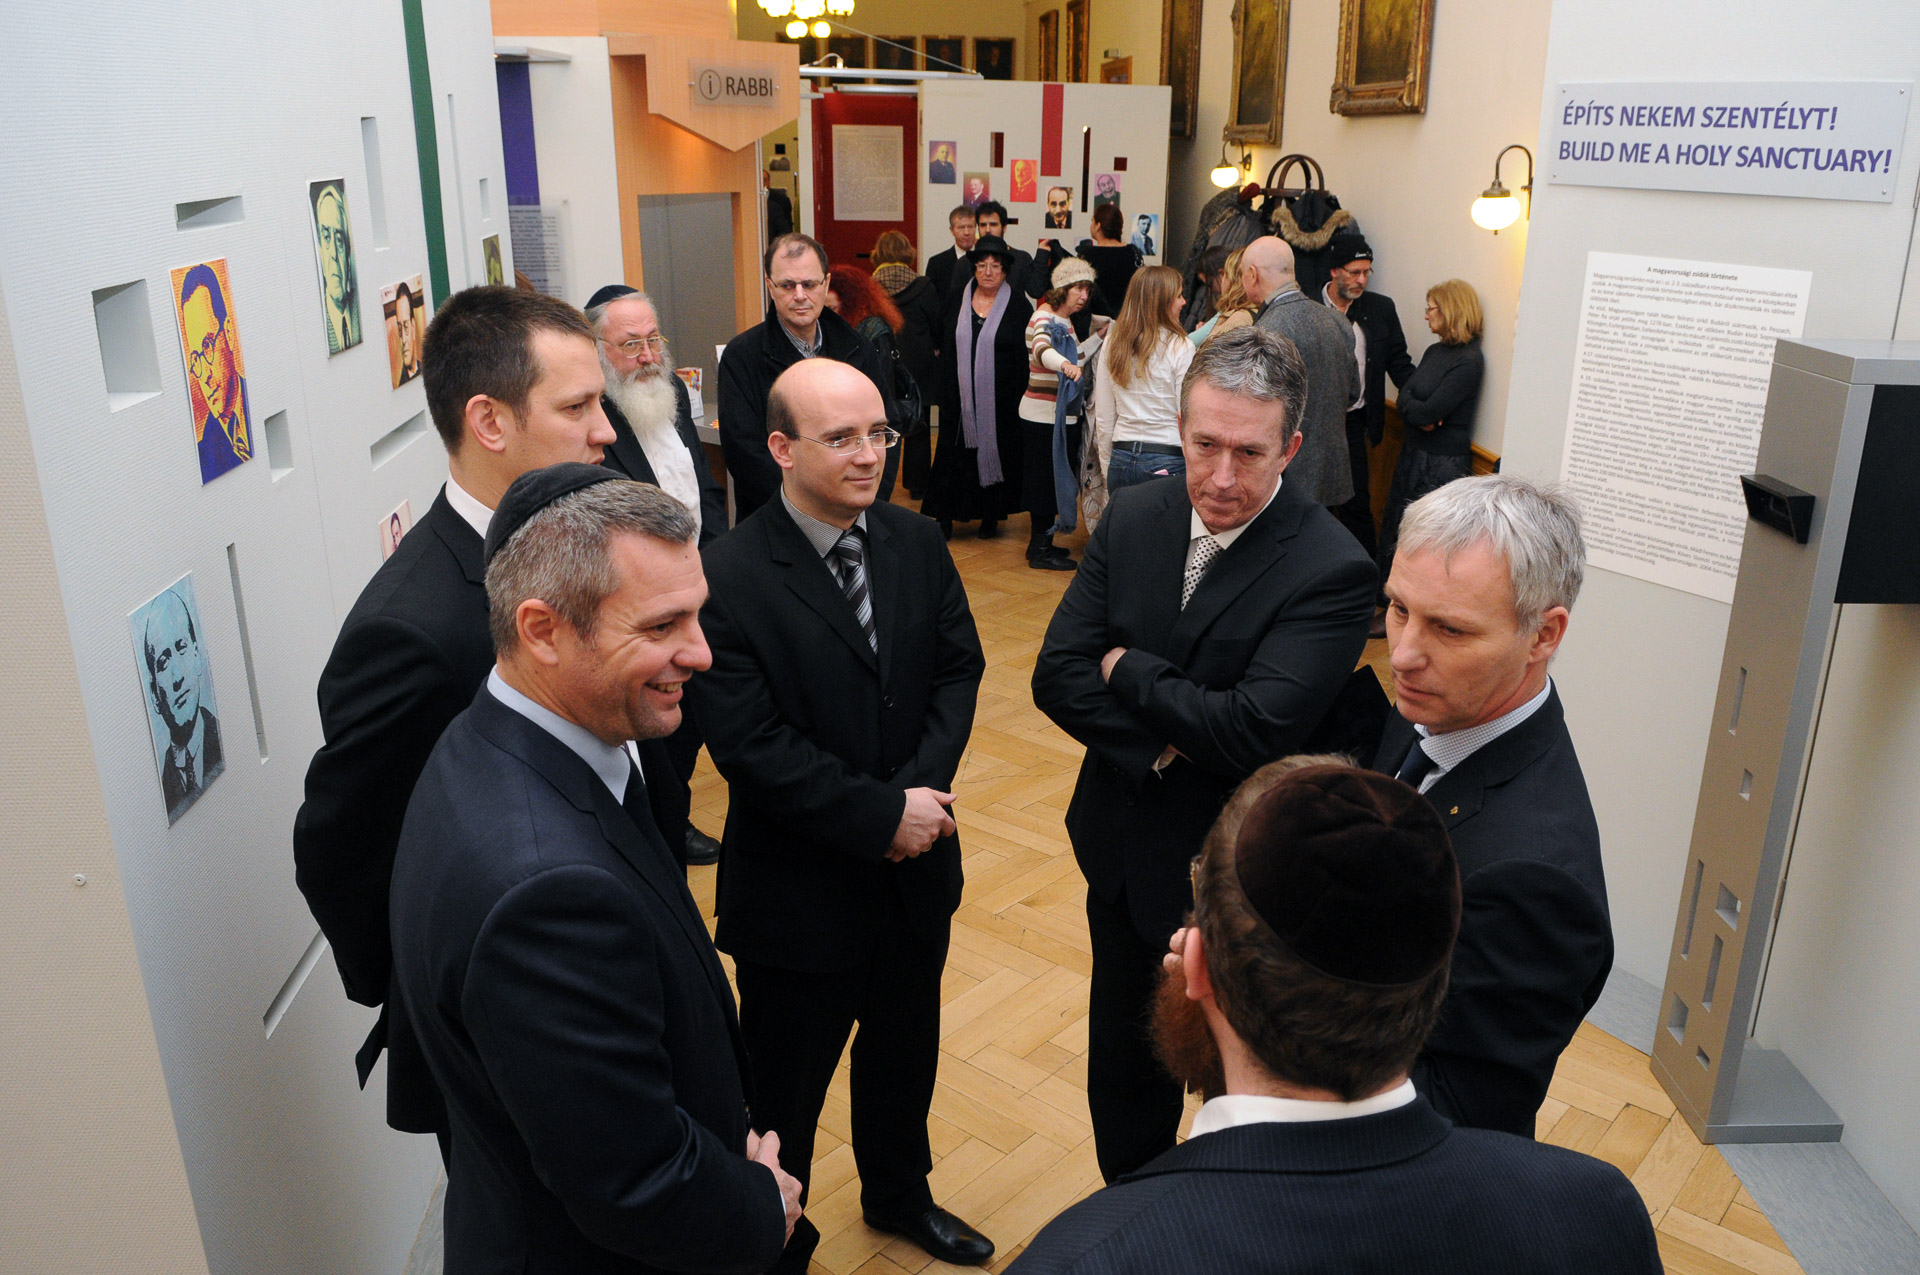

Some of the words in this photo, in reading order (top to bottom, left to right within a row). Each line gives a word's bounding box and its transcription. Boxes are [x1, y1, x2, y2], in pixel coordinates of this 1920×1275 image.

[725, 76, 773, 97] RABBI
[1563, 99, 1614, 126] ÉPÍTS
[1619, 105, 1696, 128] NEKEM
[1700, 100, 1838, 131] SZENTÉLYT!
[1558, 140, 1615, 162] BUILD
[1619, 142, 1652, 164] ME
[1654, 143, 1671, 165] A
[1675, 143, 1733, 167] HOLY
[1735, 144, 1892, 174] SANCTUARY!
[1652, 267, 1691, 277] magyarországi
[1710, 273, 1738, 281] története
